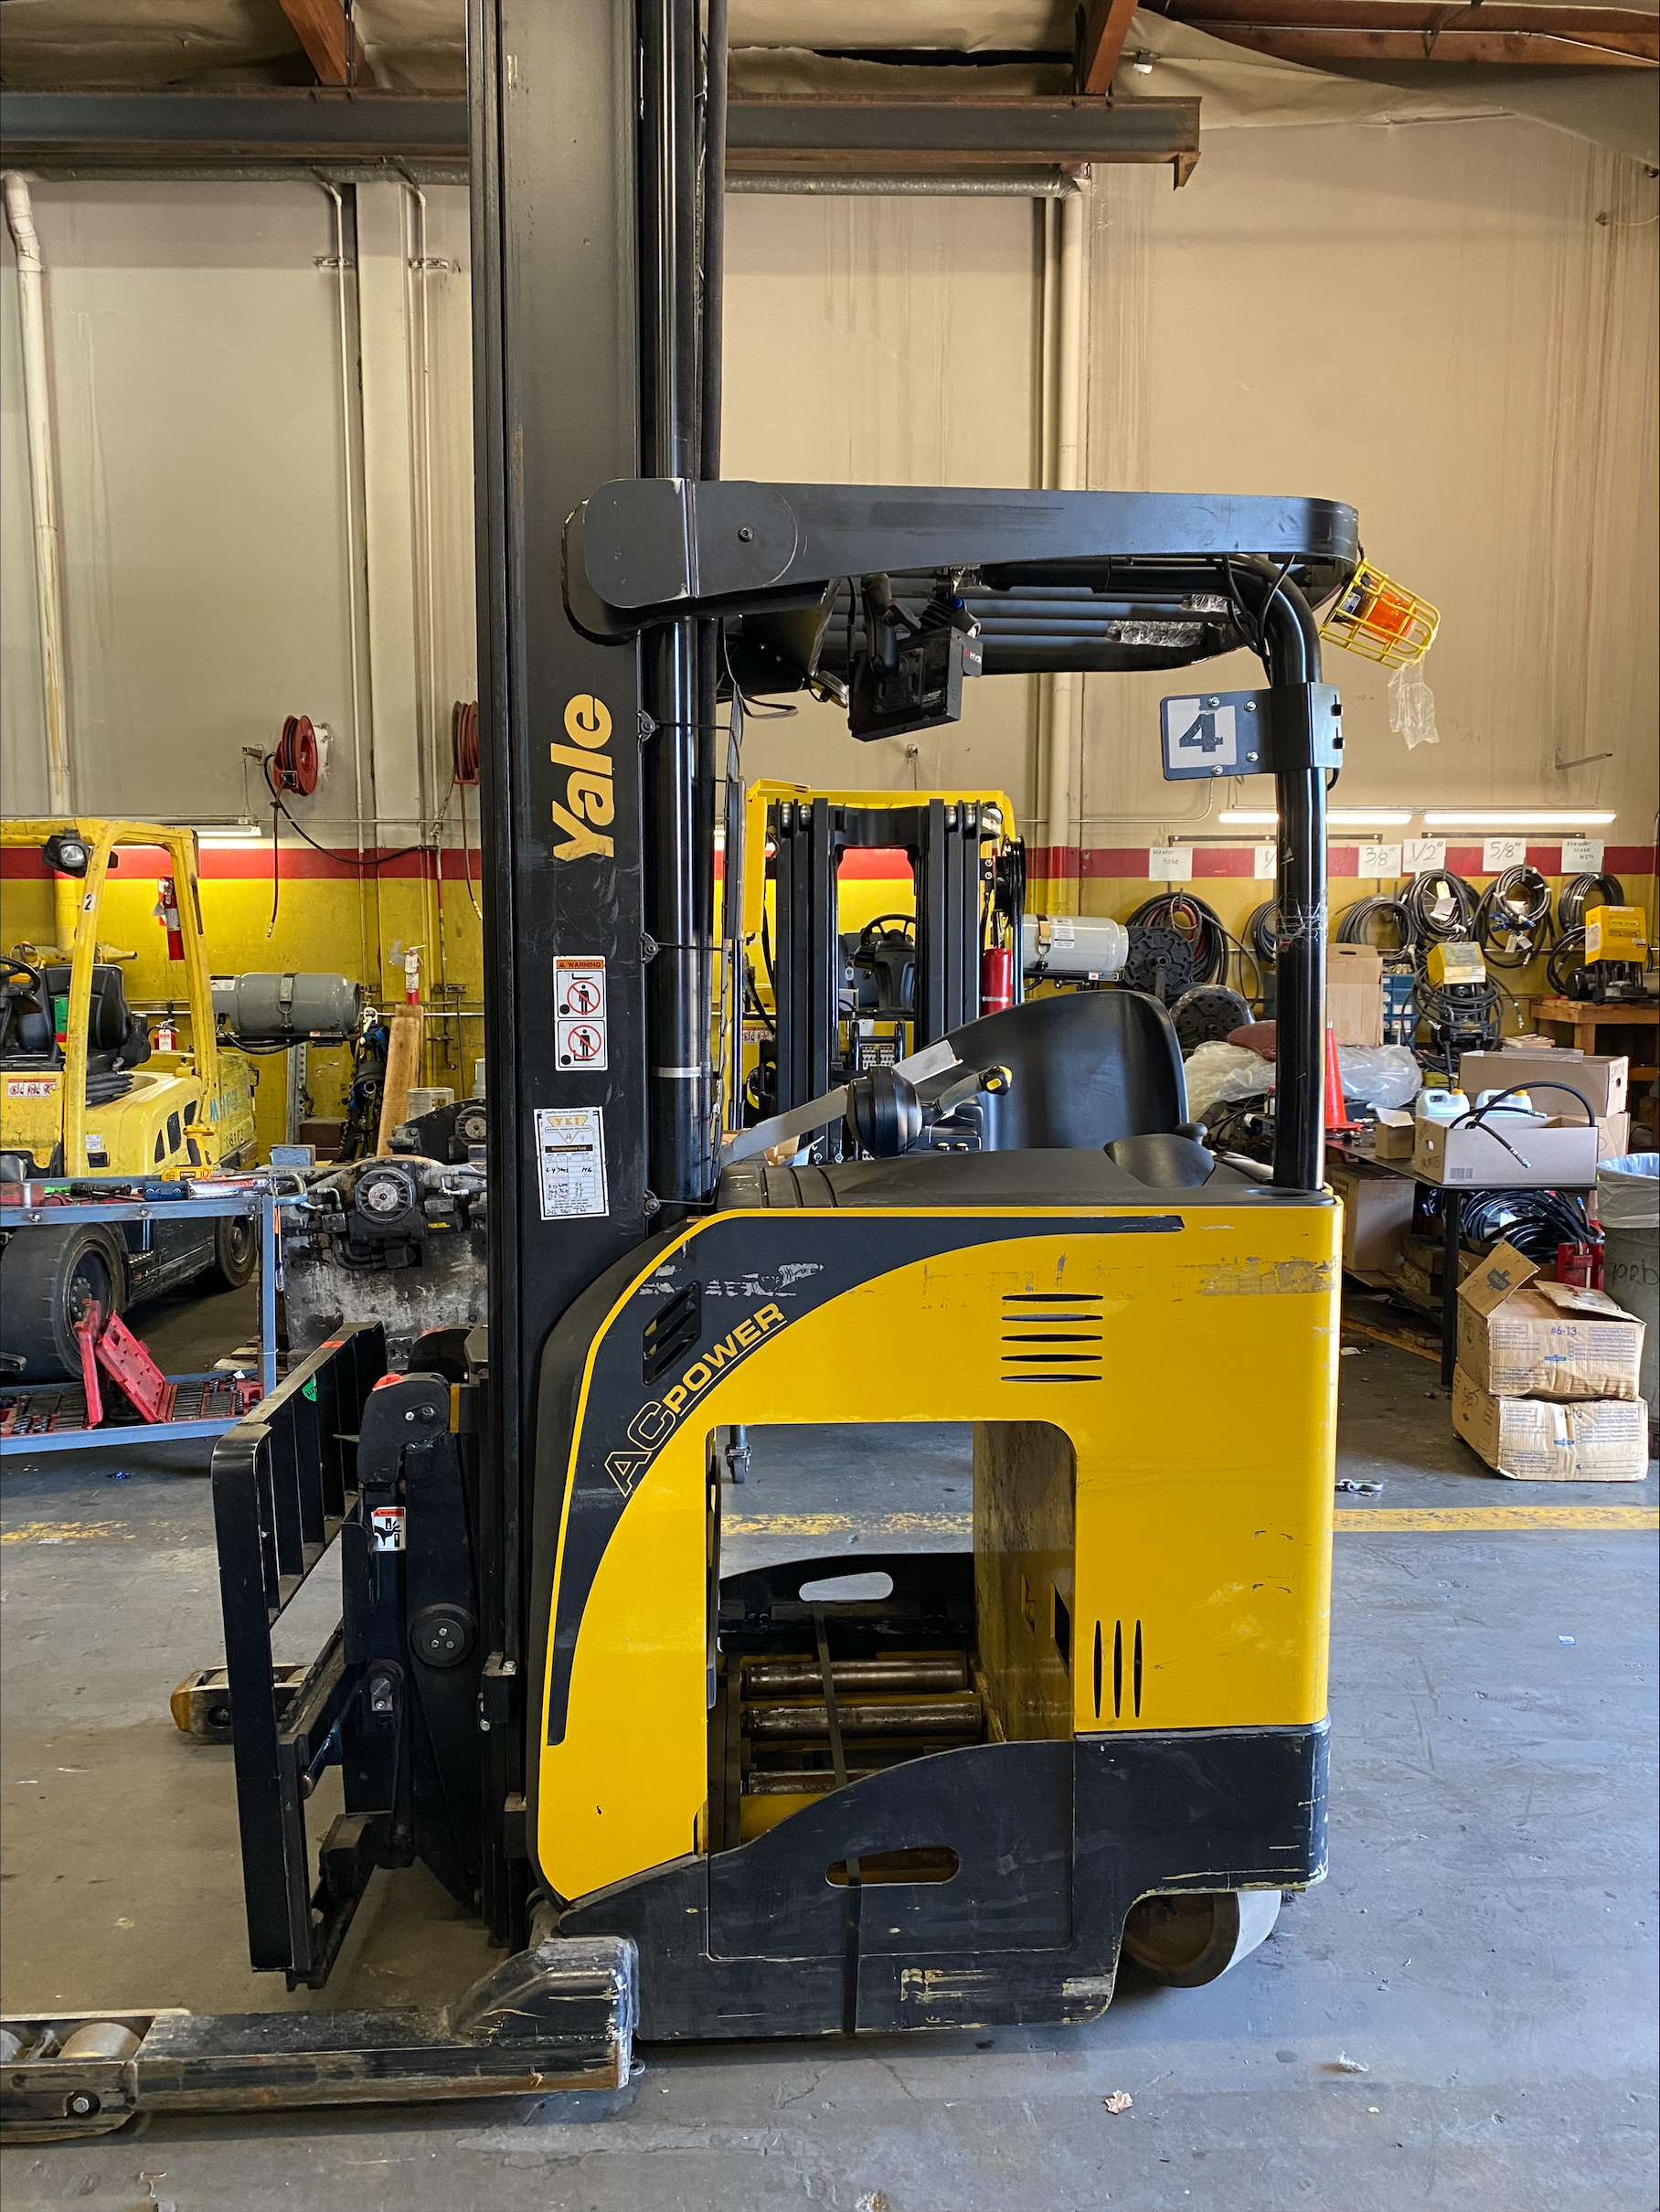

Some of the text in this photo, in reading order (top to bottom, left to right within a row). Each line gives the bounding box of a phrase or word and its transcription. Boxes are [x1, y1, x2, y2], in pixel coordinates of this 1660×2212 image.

[1179, 713, 1224, 753] 4
[550, 694, 615, 862] Yale
[1365, 846, 1397, 867] 3/8"
[1411, 841, 1444, 861] 1/2"
[1490, 841, 1521, 860] 5/8"
[83, 893, 92, 910] 2
[555, 1117, 580, 1126] YKI
[1550, 1326, 1577, 1335] #6-13
